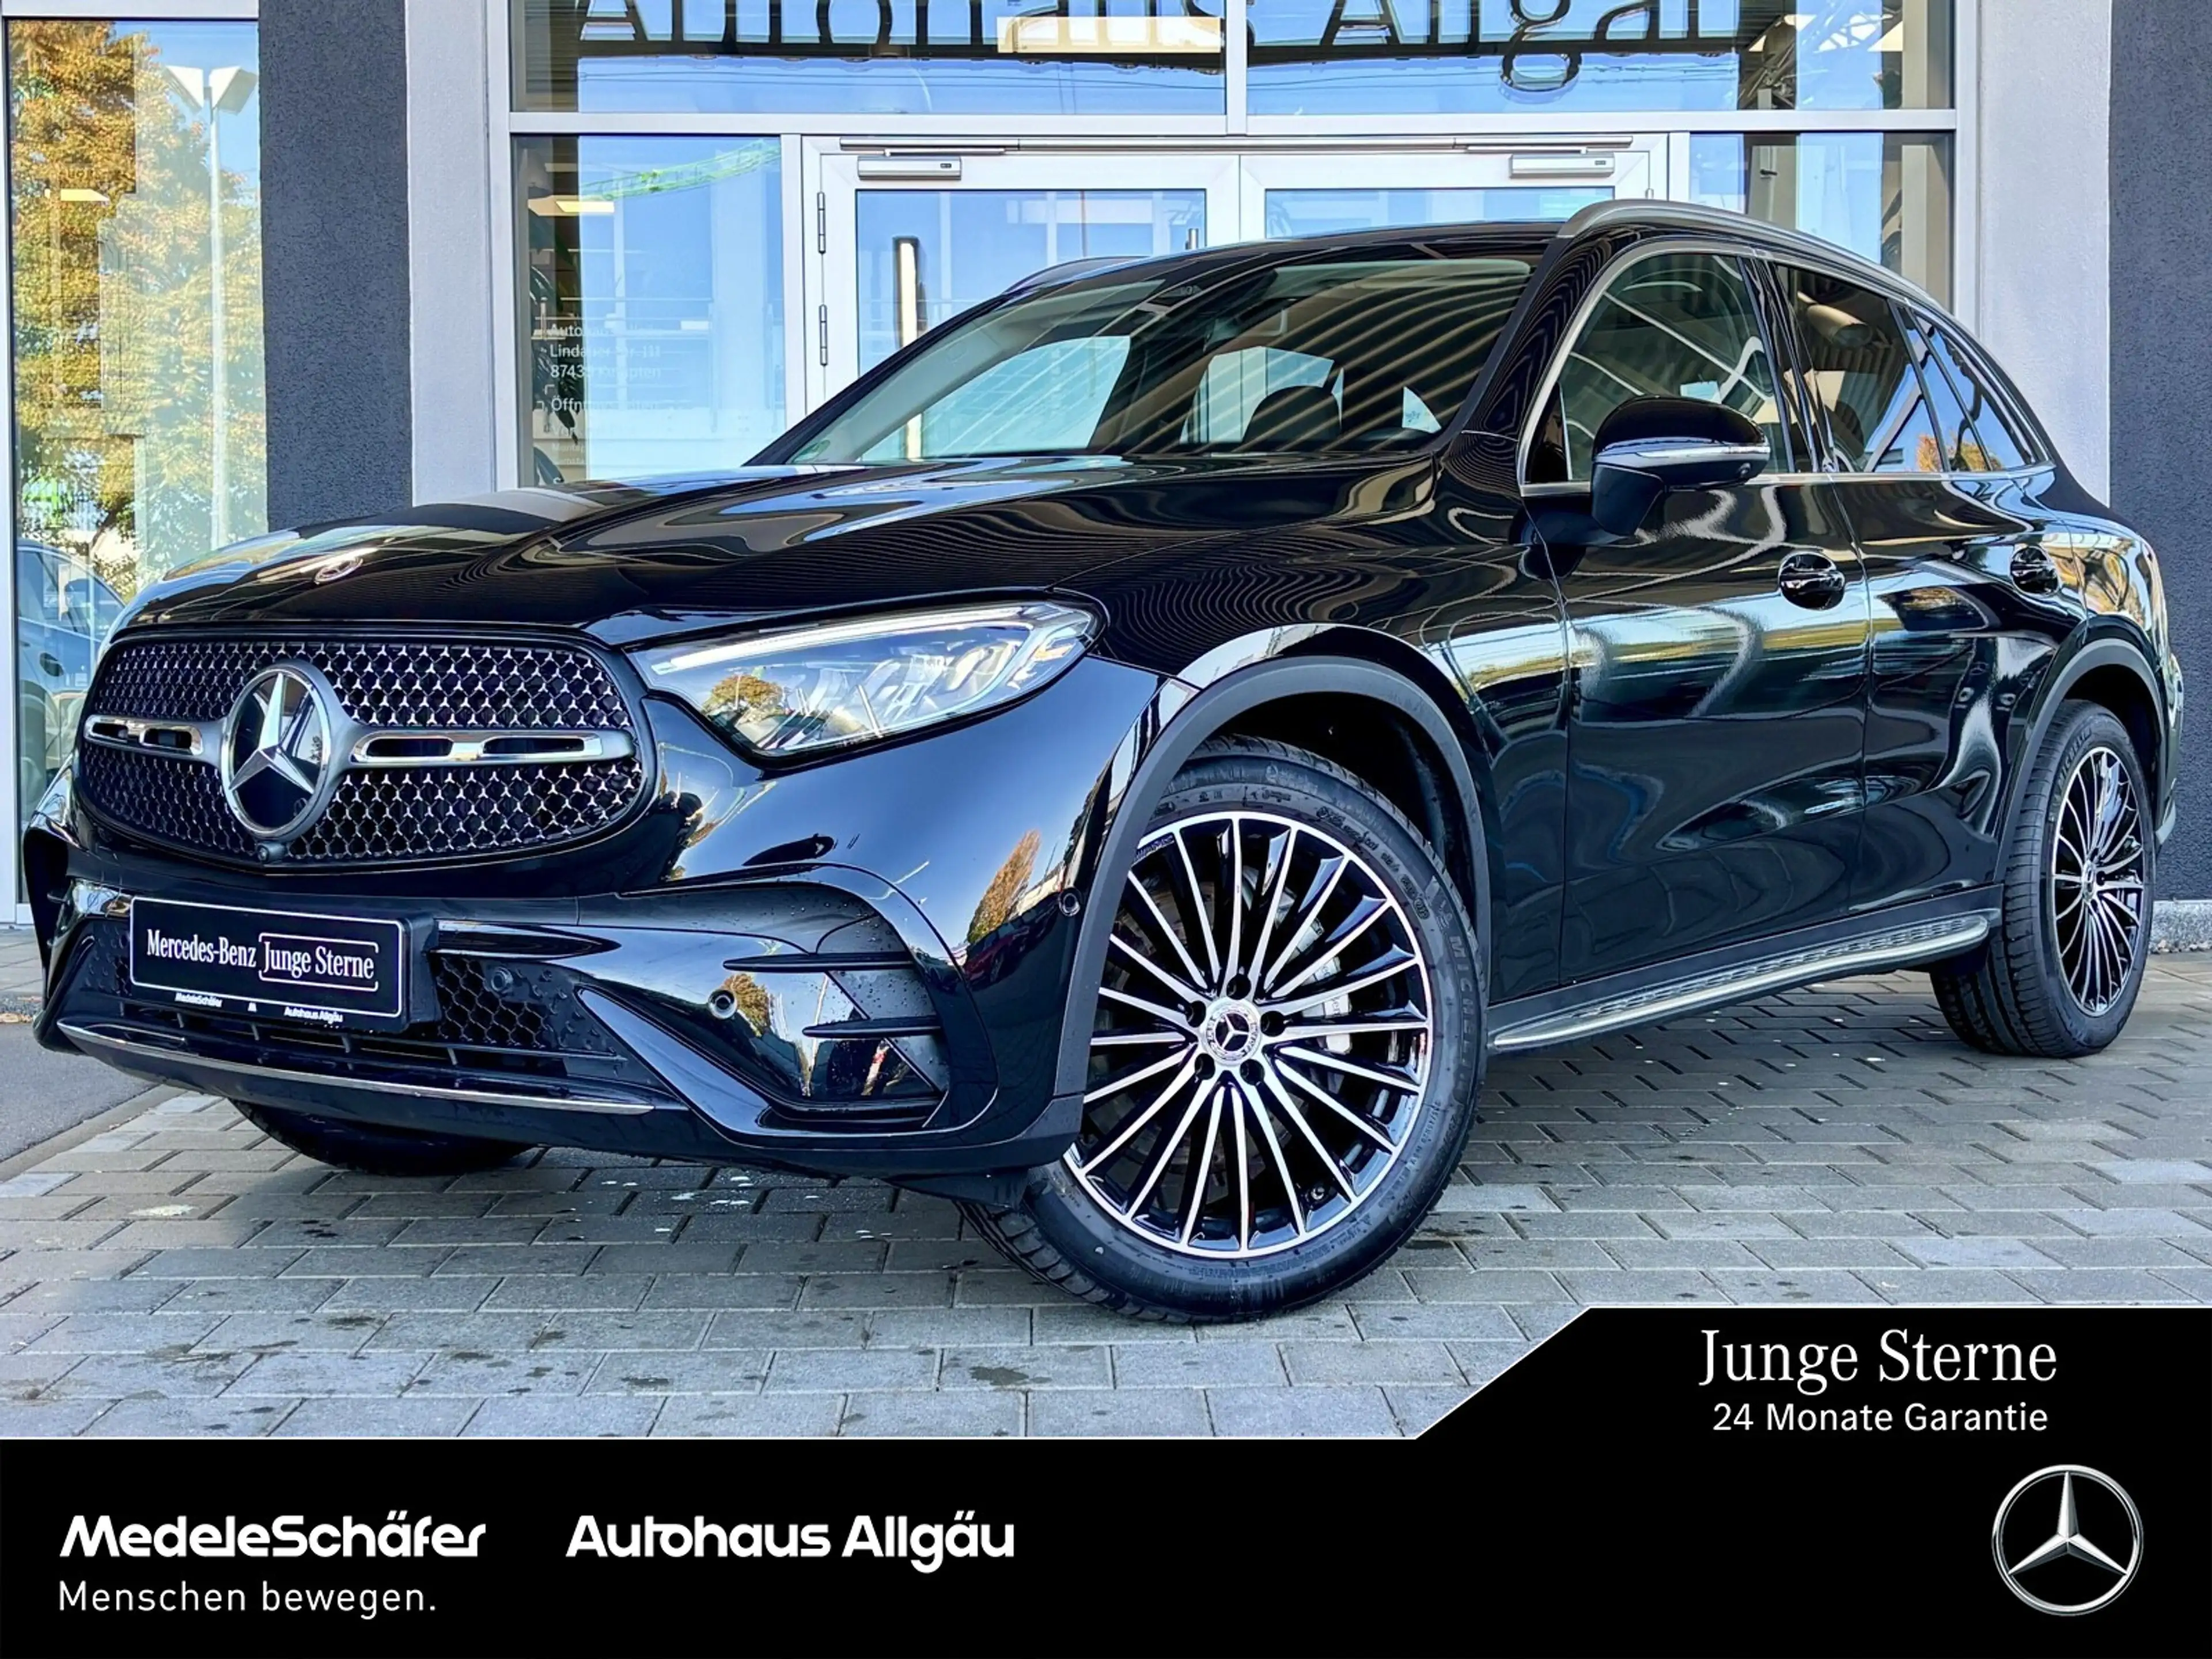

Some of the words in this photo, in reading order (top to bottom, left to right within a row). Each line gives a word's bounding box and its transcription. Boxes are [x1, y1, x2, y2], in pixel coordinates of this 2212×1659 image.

[550, 364, 591, 379] 8743
[147, 929, 257, 968] Mercedes-Benz
[263, 941, 312, 978] Junge
[315, 945, 374, 979] Sterne
